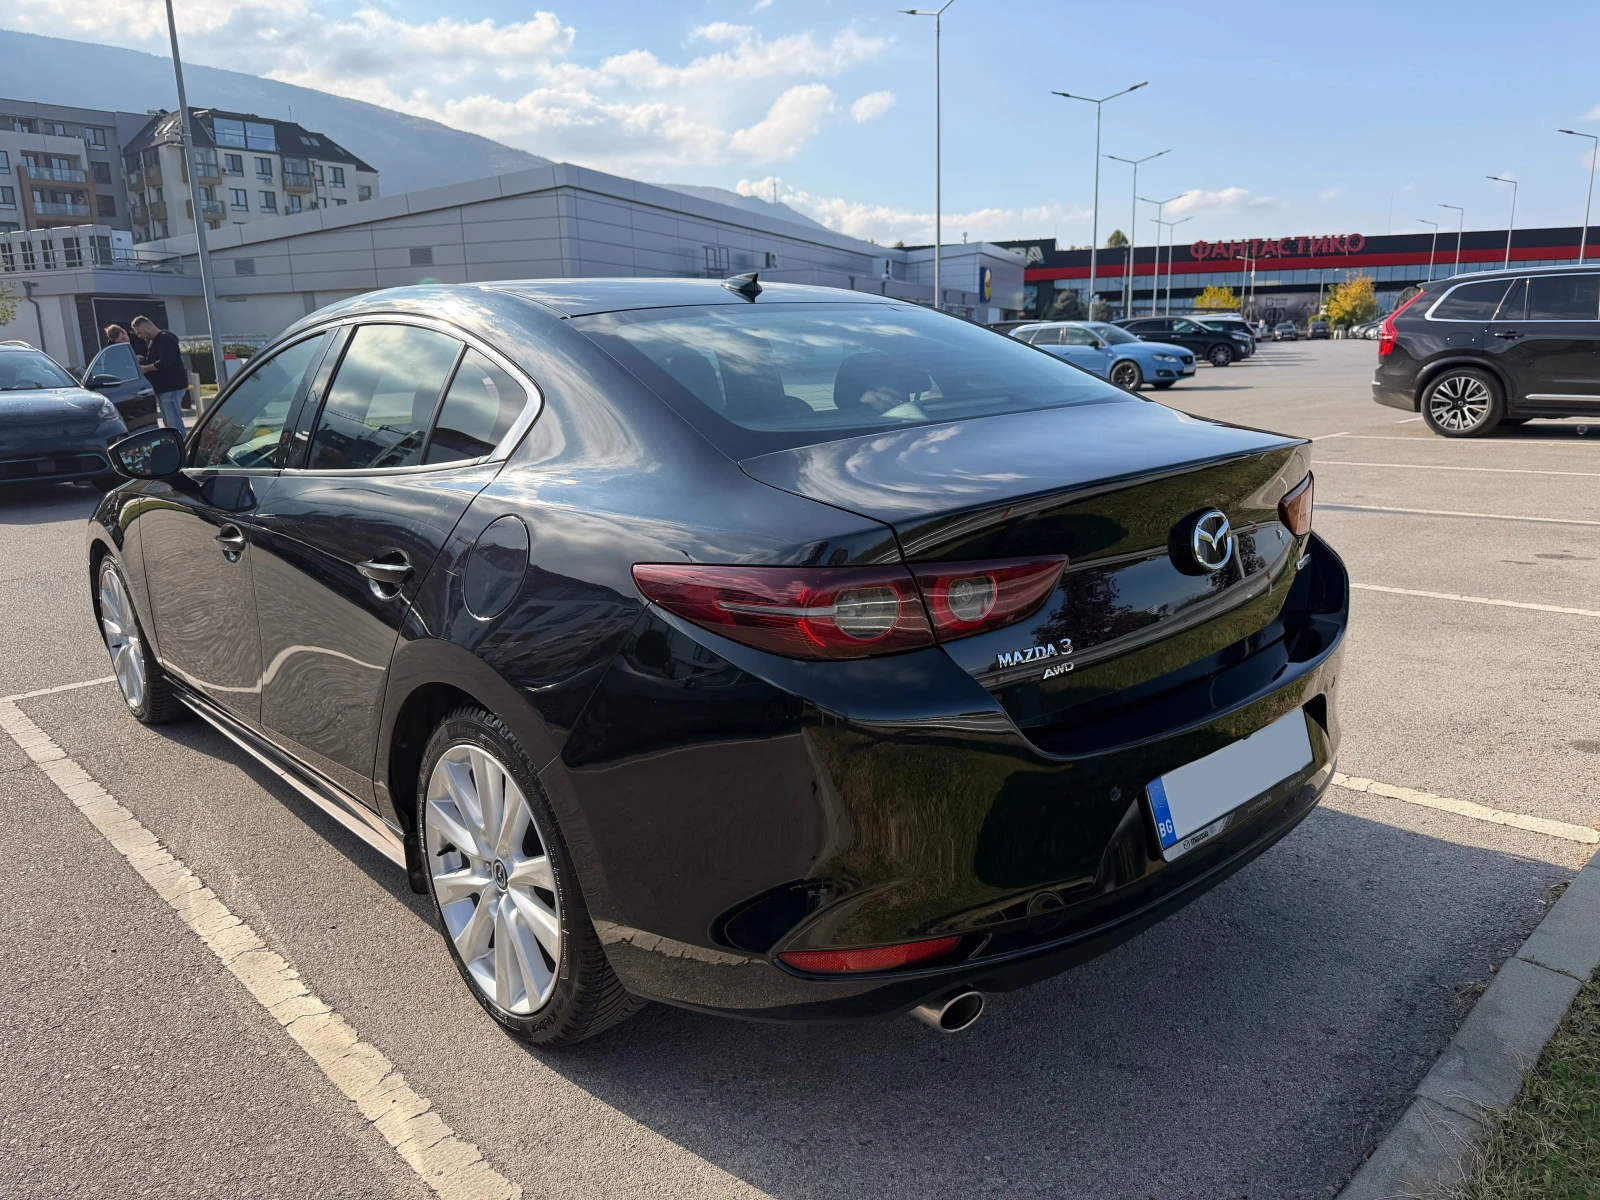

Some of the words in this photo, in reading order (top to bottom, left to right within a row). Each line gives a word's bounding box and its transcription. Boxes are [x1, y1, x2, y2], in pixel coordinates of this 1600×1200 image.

[1190, 233, 1366, 260] ФАНТАСТИКО
[996, 643, 1059, 669] MAZDA
[1059, 637, 1074, 656] 3
[1042, 661, 1075, 680] AWD
[1158, 818, 1174, 838] BG
[531, 1009, 559, 1034] Kleber
